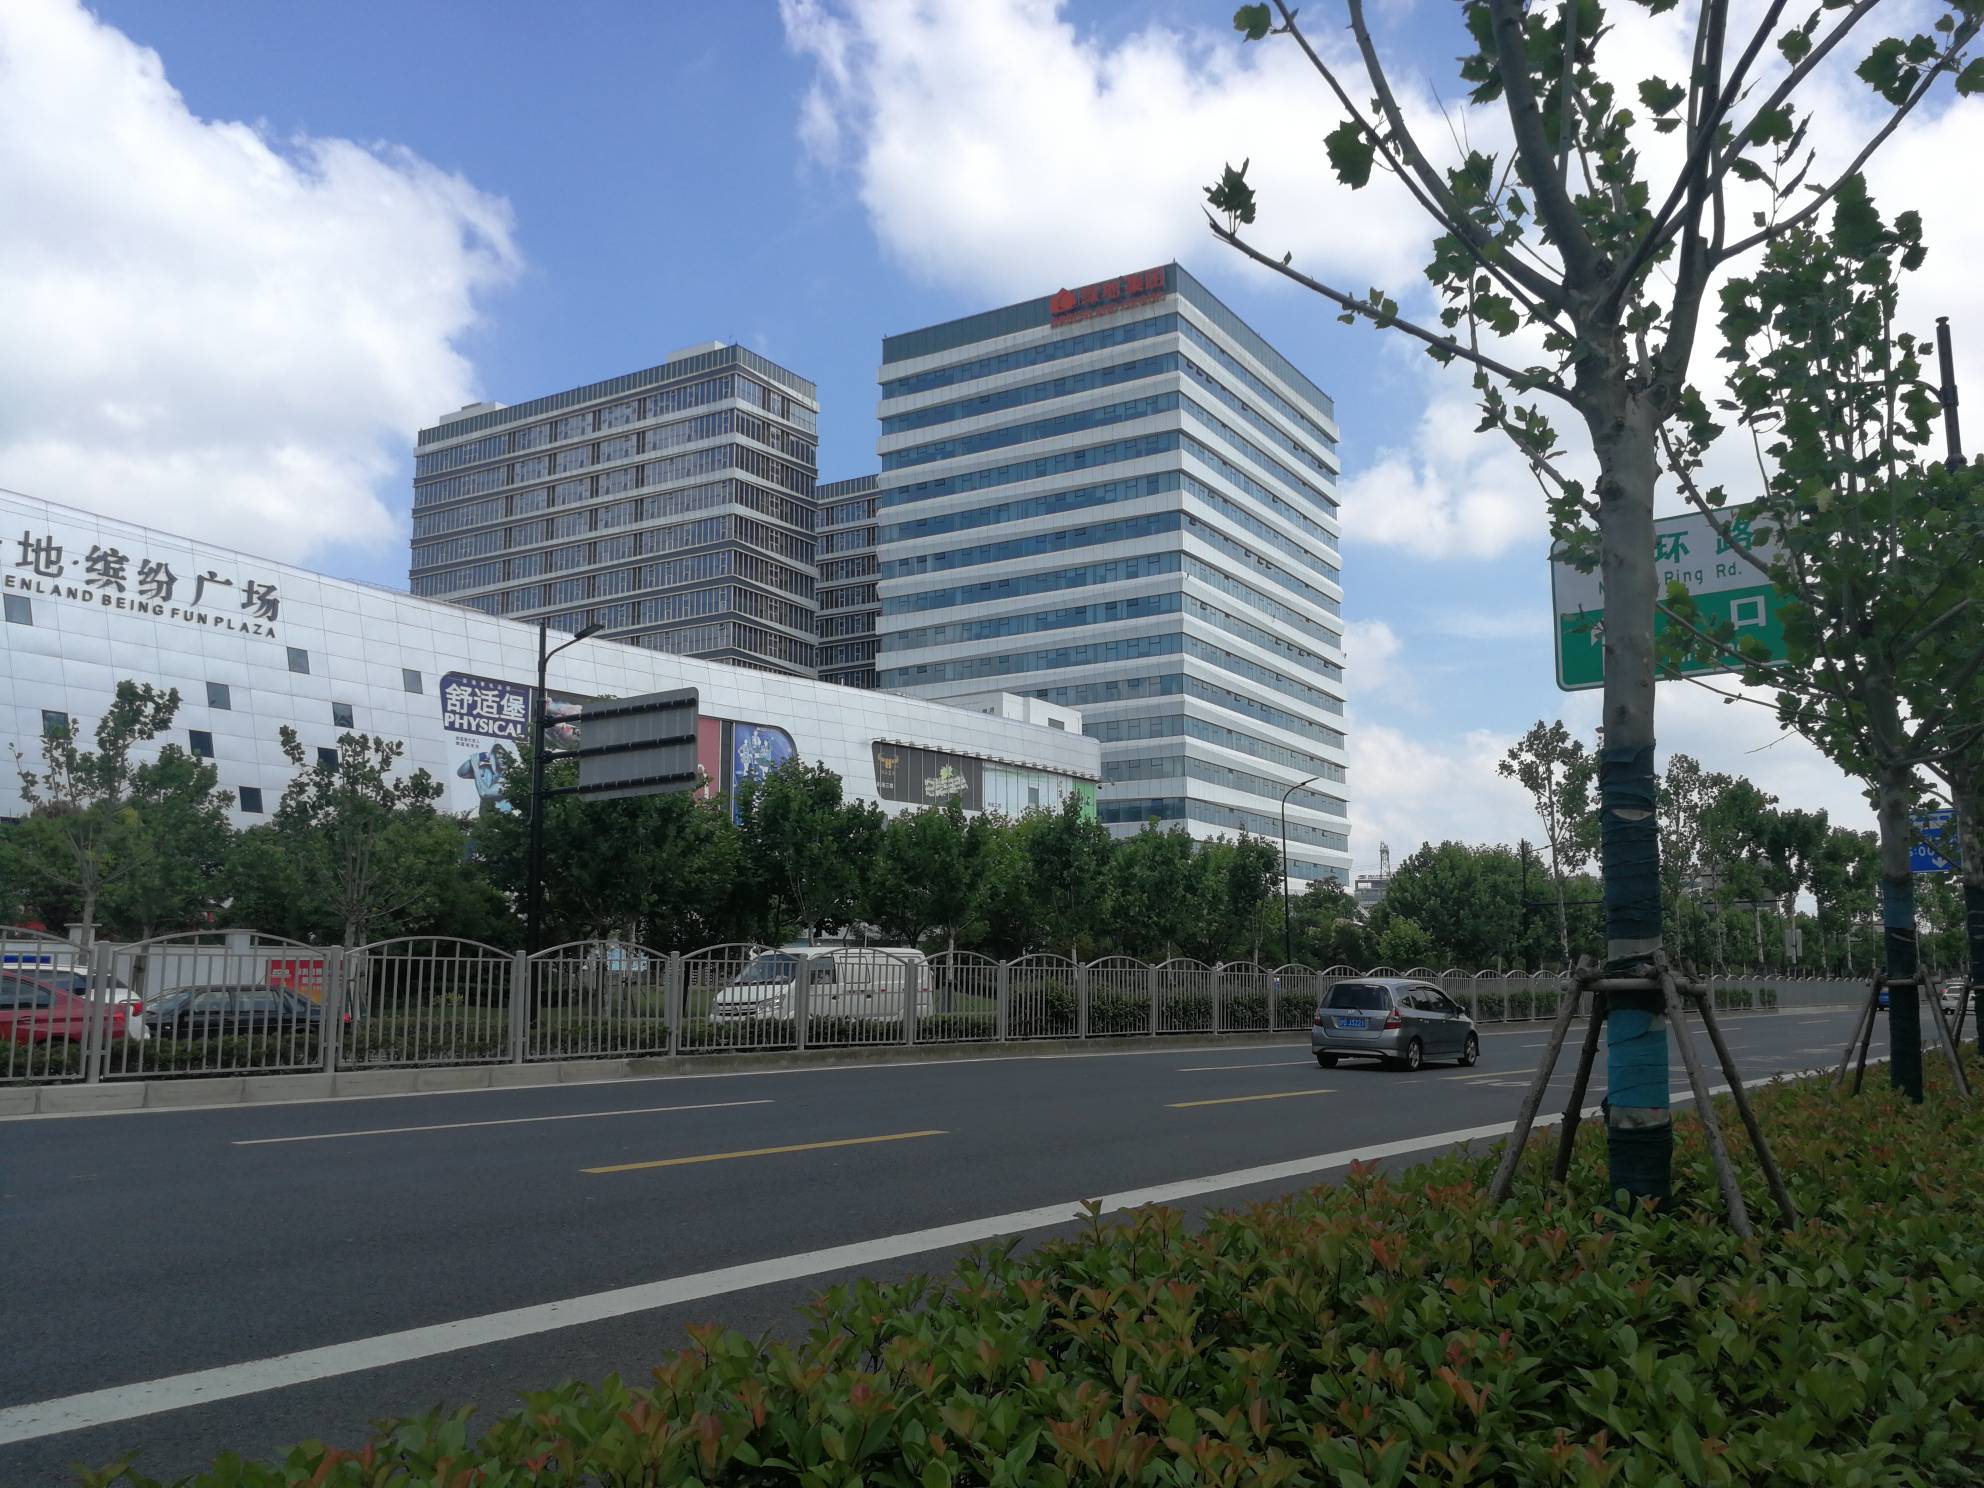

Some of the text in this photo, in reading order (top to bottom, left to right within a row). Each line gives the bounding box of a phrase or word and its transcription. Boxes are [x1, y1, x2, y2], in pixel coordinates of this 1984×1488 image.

[0, 530, 280, 622] 地·缤纷广场
[1716, 562, 1742, 578] Rd.
[101, 594, 164, 616] BEING
[170, 607, 208, 625] FUN
[214, 616, 276, 639] PLAZA
[445, 683, 526, 722] 舒适堡
[444, 712, 525, 738] PHYSICAL
